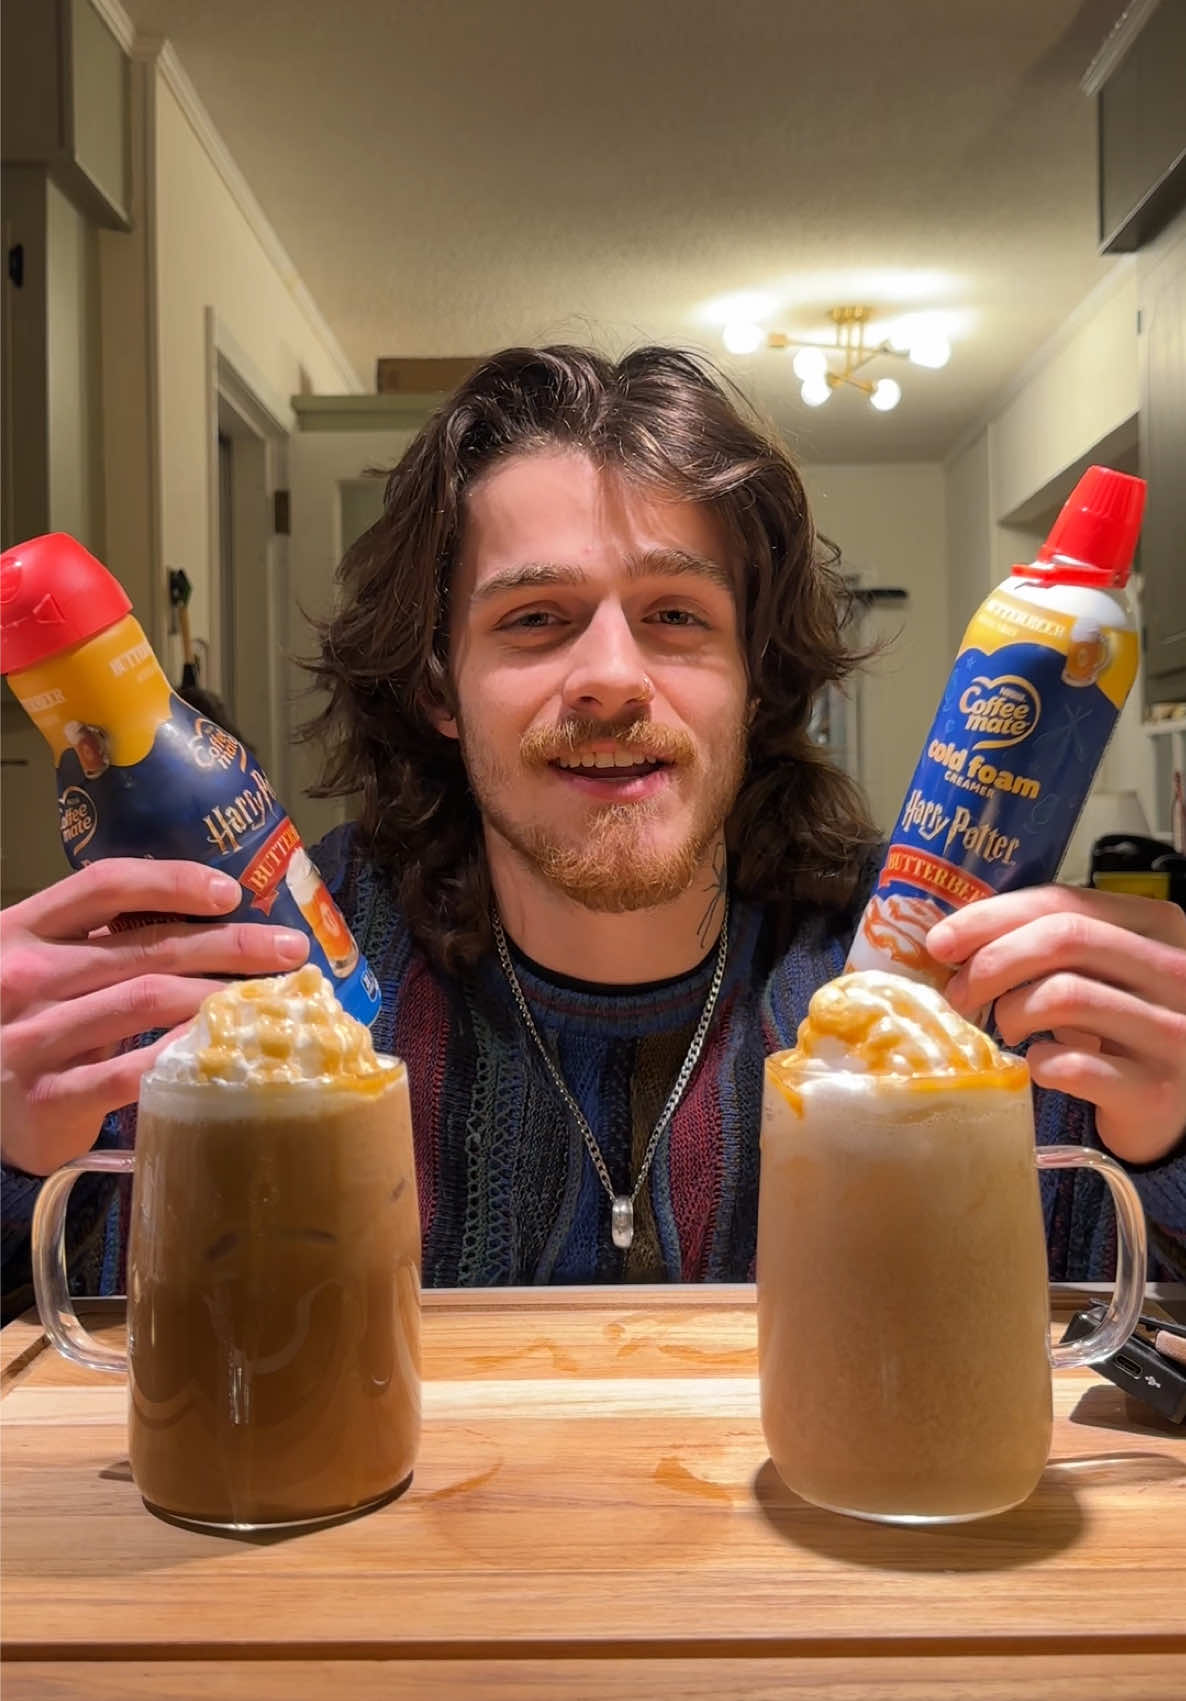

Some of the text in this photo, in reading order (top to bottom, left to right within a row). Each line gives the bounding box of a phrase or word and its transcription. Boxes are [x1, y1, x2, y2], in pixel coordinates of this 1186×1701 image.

[959, 686, 1030, 719] Coffee
[965, 713, 1027, 735] mate
[928, 739, 1040, 798] cold foam
[944, 770, 995, 798] CREAMER
[60, 803, 88, 829] offee
[203, 790, 266, 855] Harry
[902, 790, 1020, 864] Harry Potter
